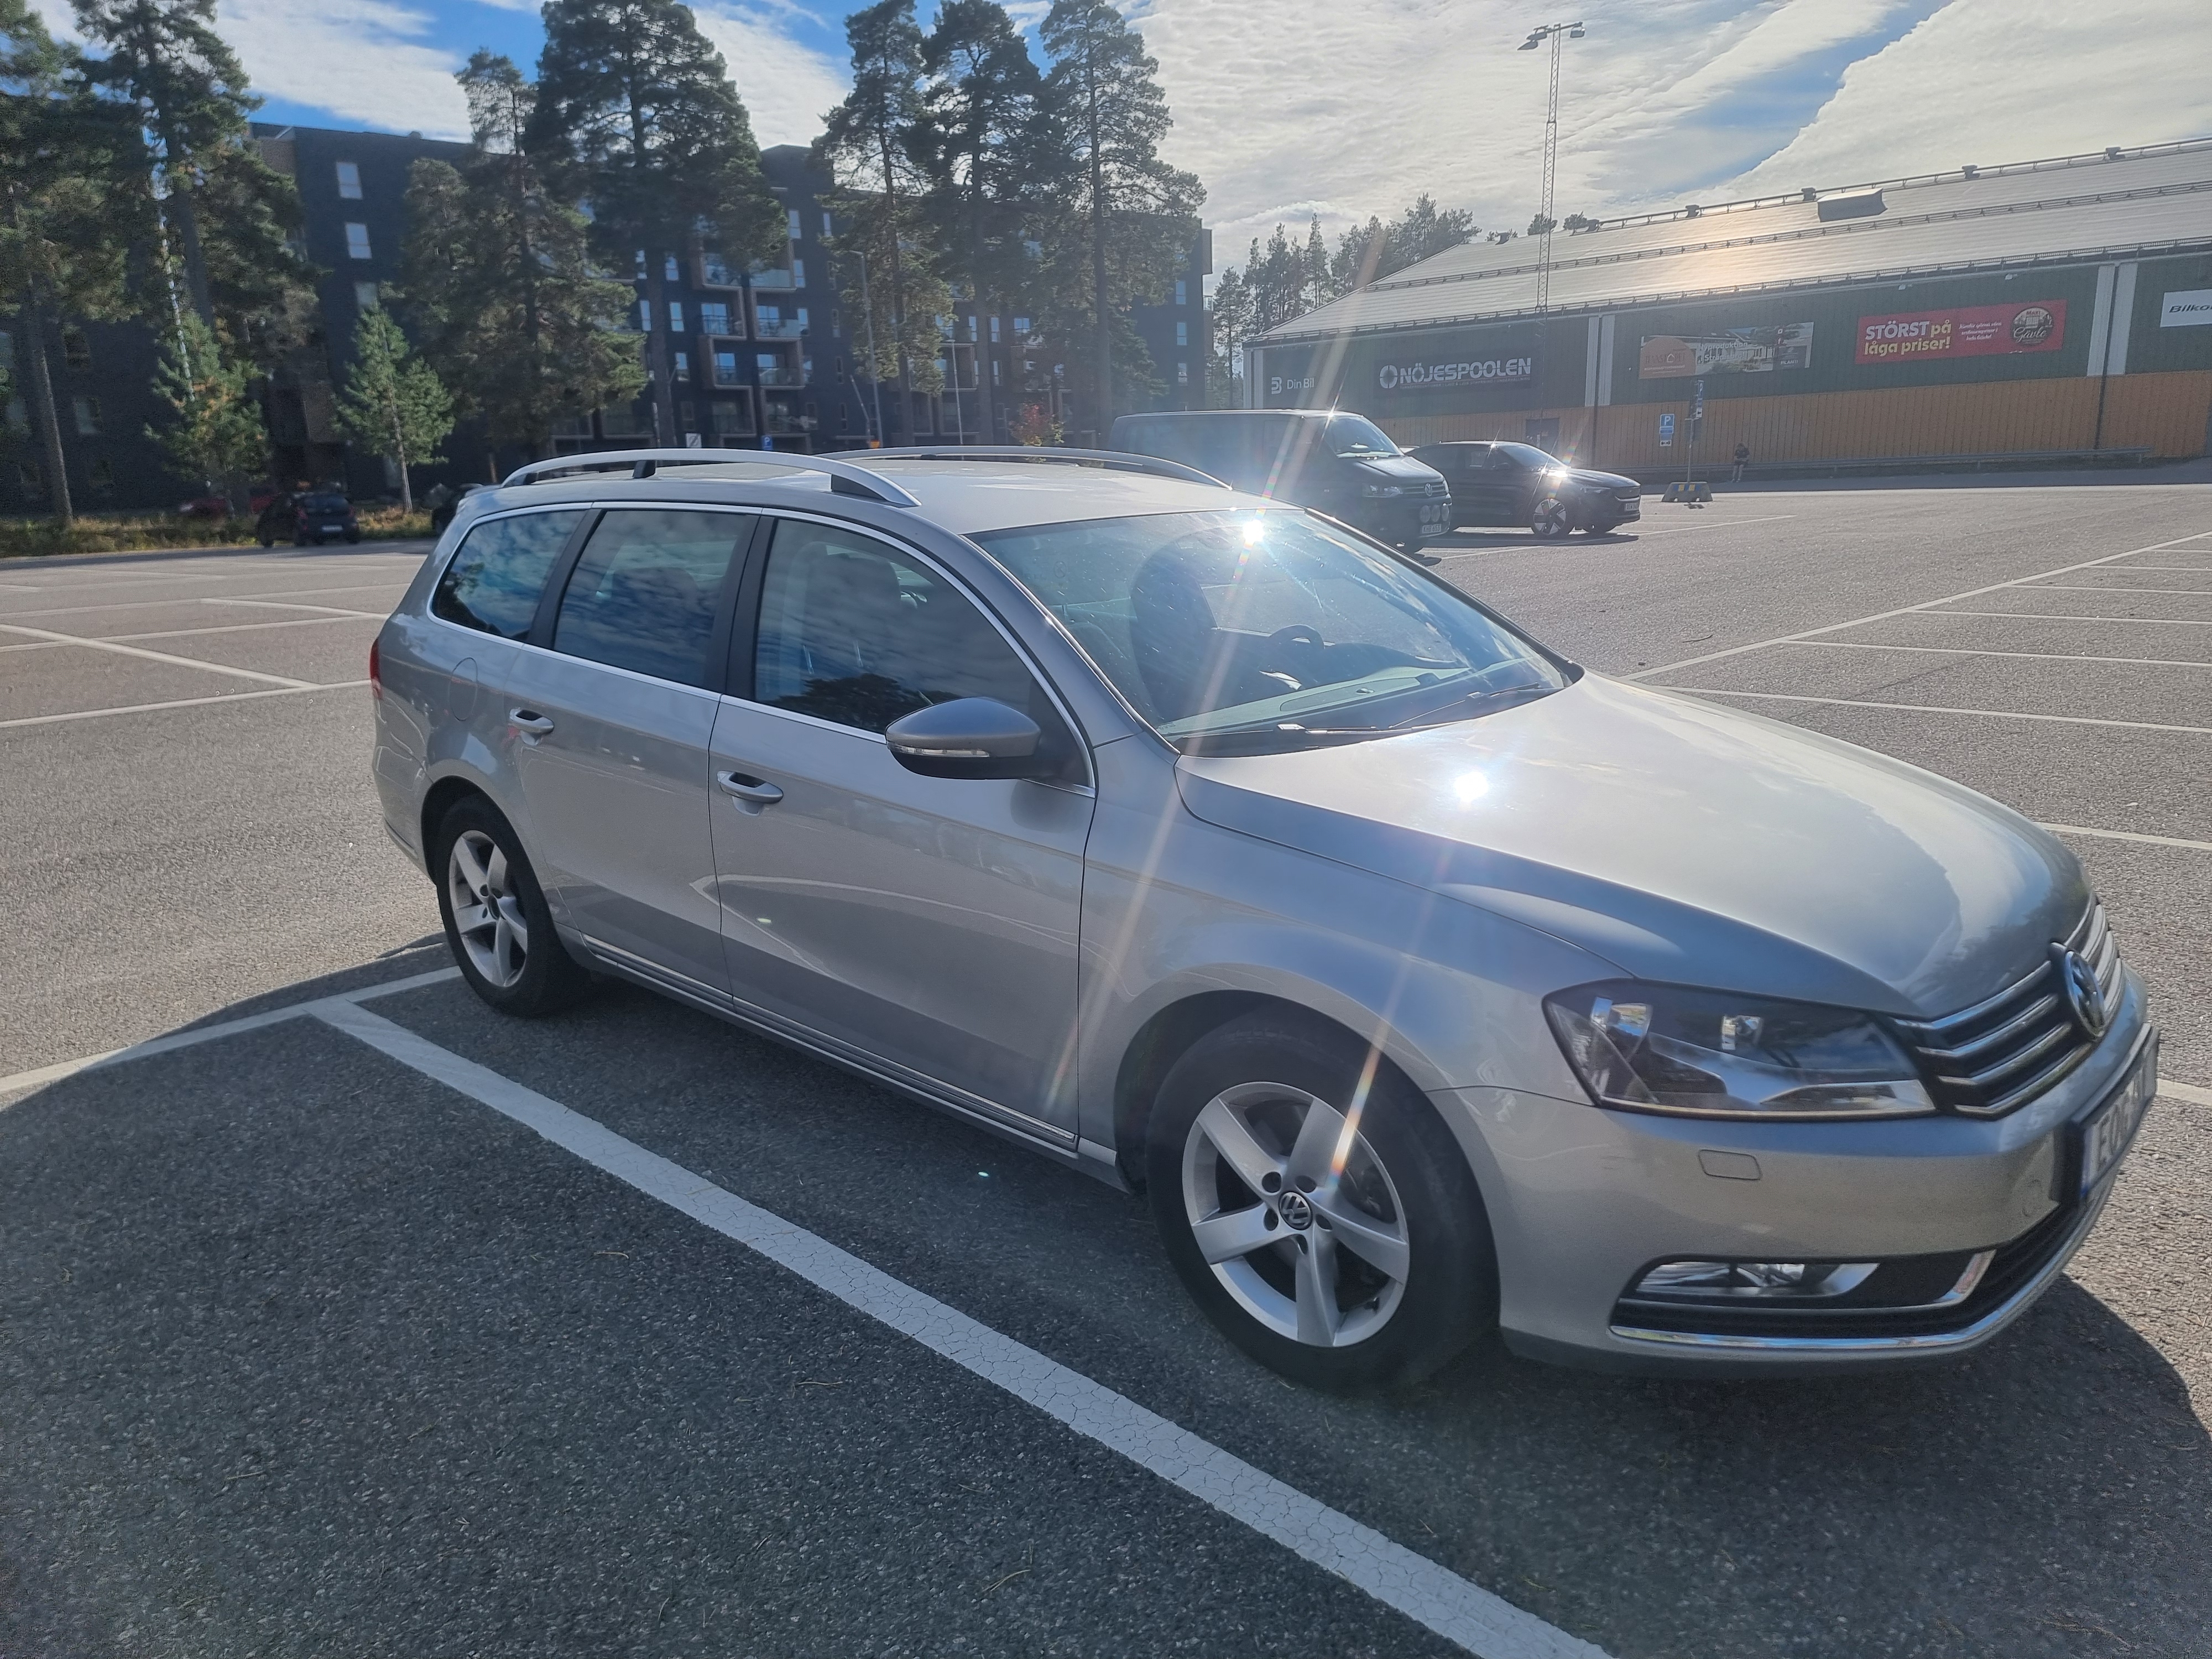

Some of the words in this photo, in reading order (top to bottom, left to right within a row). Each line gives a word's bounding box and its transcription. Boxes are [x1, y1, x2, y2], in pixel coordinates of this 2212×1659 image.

[2169, 304, 2212, 313] Bilko
[1865, 320, 1930, 340] STÖRST
[1931, 319, 1952, 338] på
[2013, 326, 2047, 343] Gävle
[1864, 341, 1898, 357] låga
[1901, 336, 1951, 355] priser!
[1400, 357, 1531, 384] NÖJESPOOLEN
[1287, 379, 1302, 389] Din
[1303, 377, 1314, 388] Bil
[1664, 415, 1671, 426] P
[764, 436, 770, 446] P
